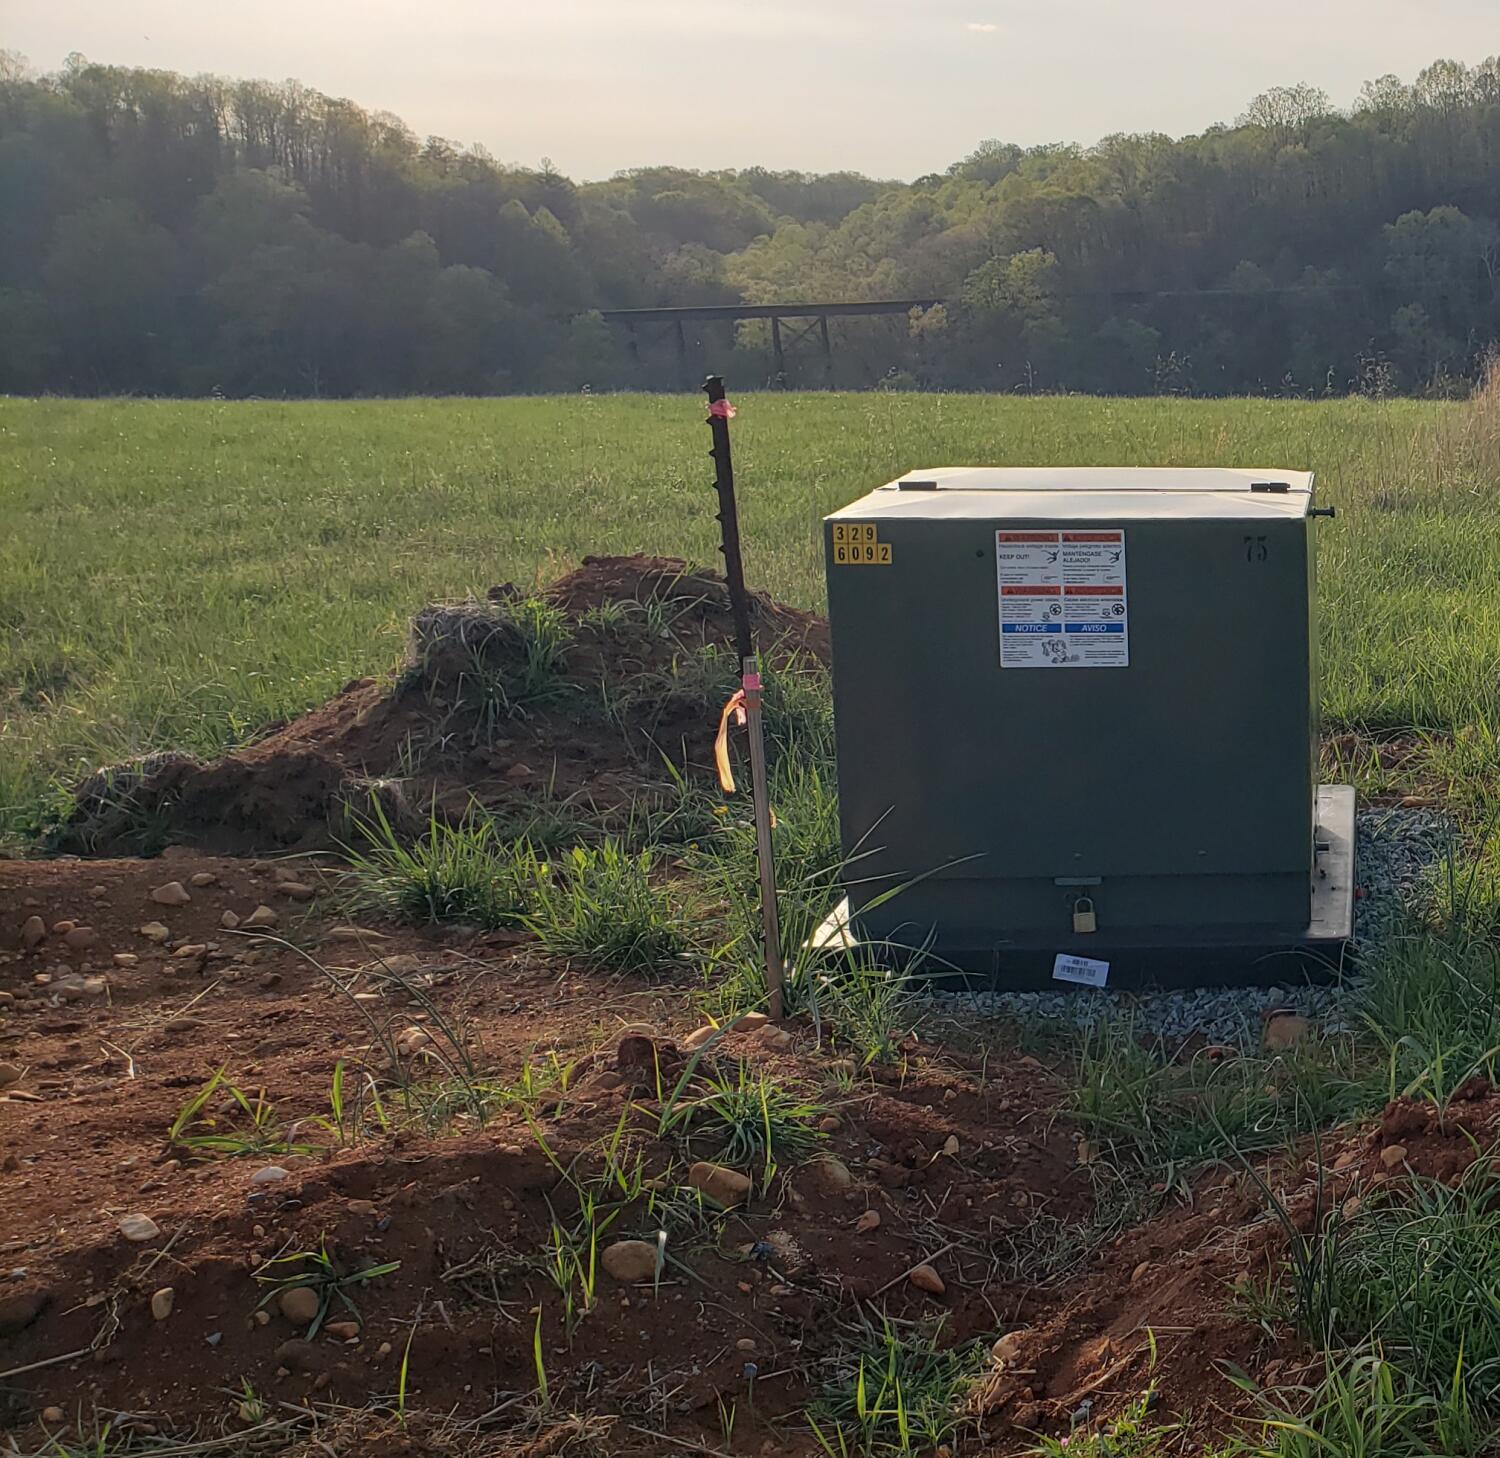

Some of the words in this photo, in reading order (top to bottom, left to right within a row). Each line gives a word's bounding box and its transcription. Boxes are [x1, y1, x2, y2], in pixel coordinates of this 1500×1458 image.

[837, 546, 889, 561] 6092
[1014, 623, 1048, 632] NOTICE
[1080, 623, 1107, 632] AVISO
